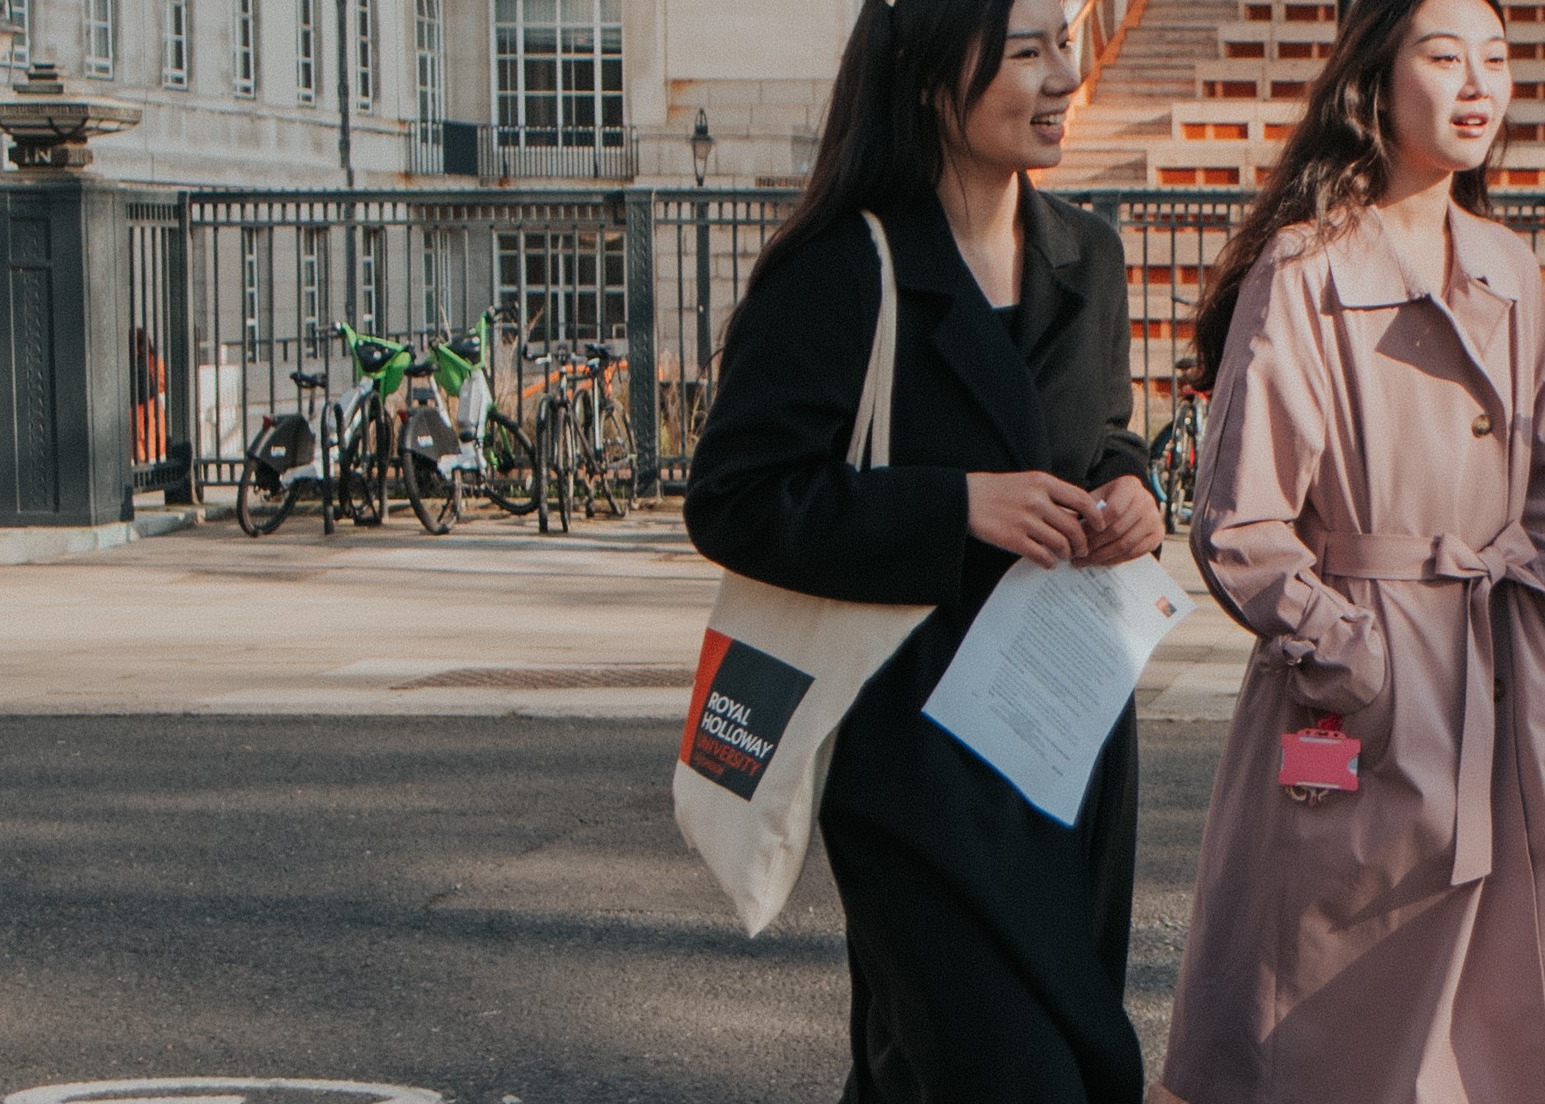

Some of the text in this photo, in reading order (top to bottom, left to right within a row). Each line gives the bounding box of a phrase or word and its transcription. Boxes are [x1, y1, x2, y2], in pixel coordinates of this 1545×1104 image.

[23, 147, 52, 164] IN
[707, 691, 751, 726] ROYAL
[700, 711, 774, 759] HOLLOWAY
